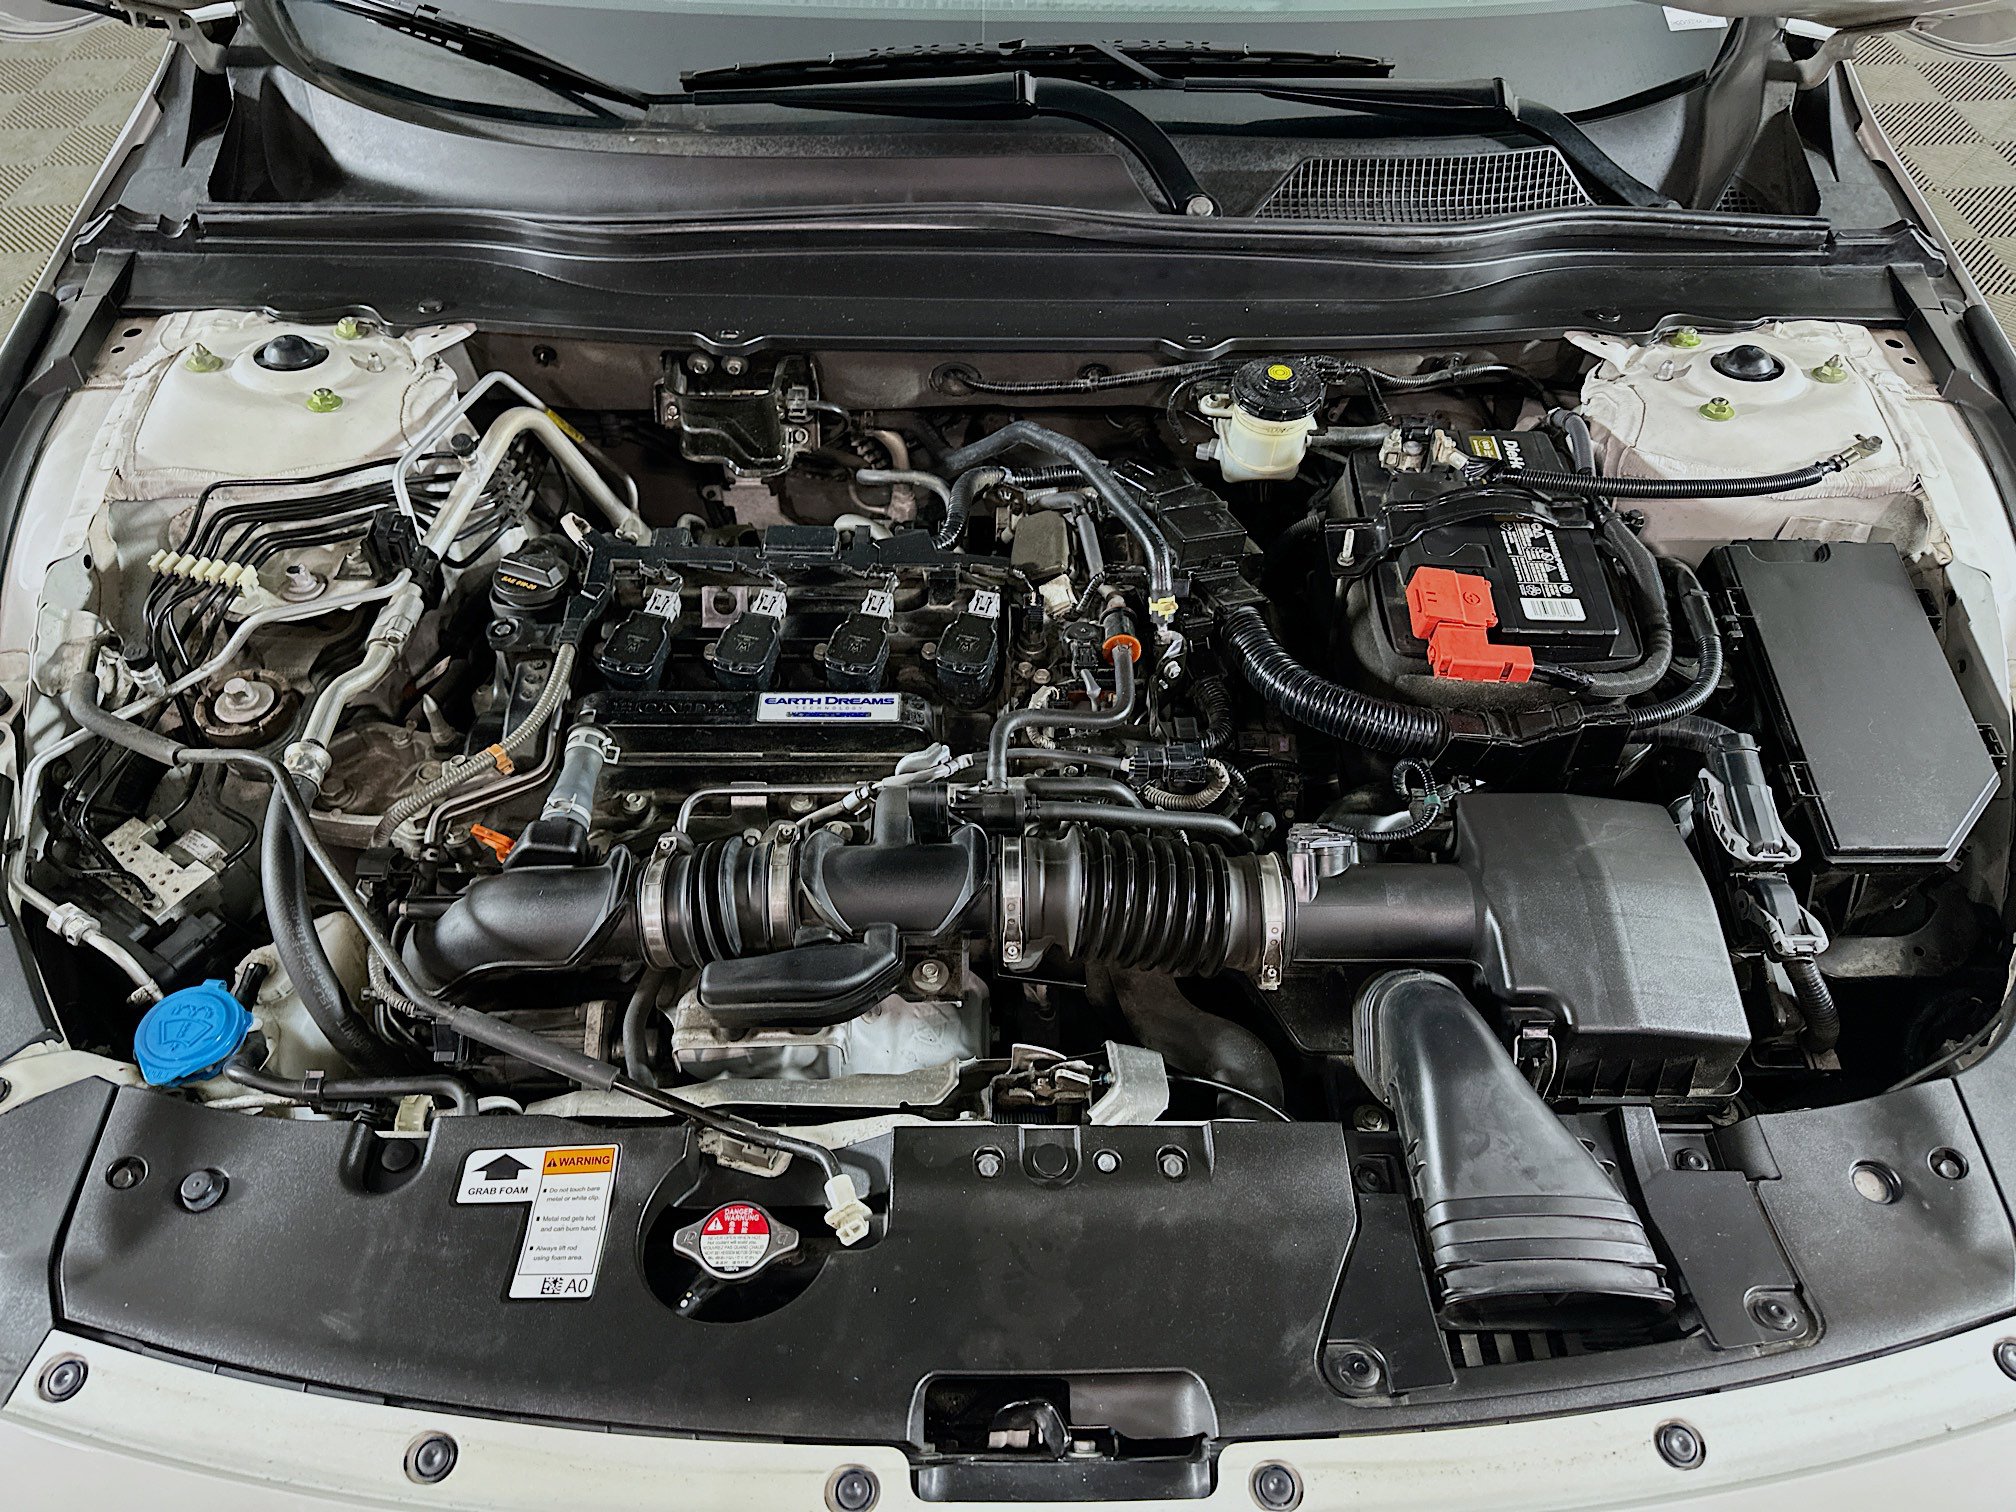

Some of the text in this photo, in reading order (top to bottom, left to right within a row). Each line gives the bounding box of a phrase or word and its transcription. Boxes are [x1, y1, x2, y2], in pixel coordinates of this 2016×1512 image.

[1502, 439, 1526, 470] DieH
[764, 696, 895, 705] EARTH DREAMS
[559, 1155, 610, 1167] WARNING
[468, 1186, 529, 1196] GRAB FOAM
[564, 1278, 588, 1293] A0
